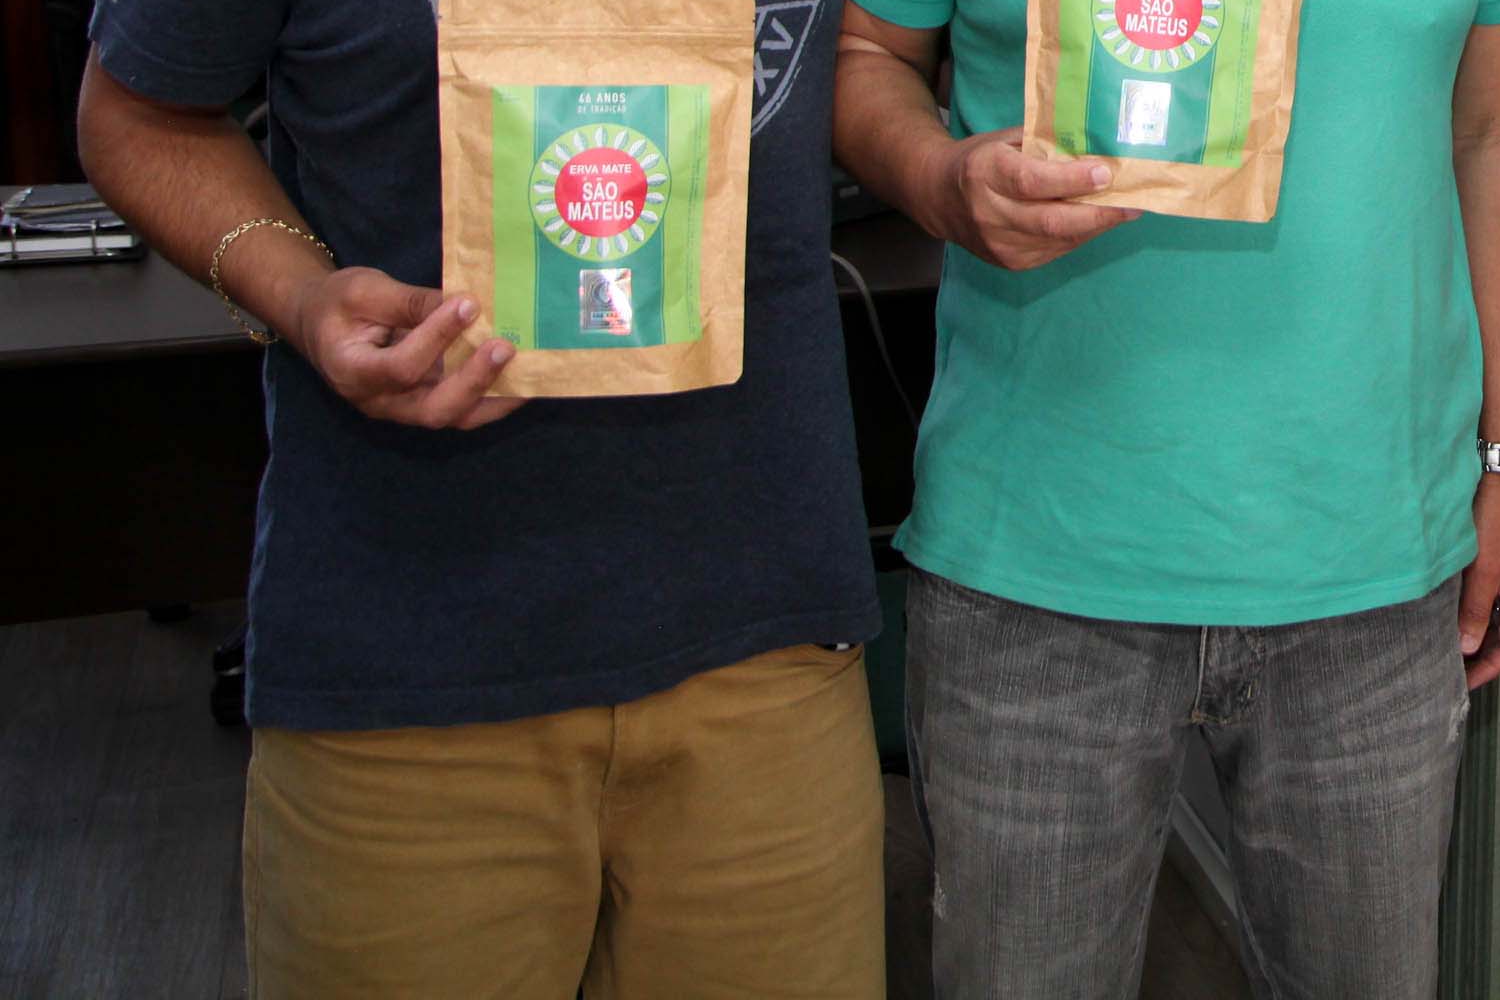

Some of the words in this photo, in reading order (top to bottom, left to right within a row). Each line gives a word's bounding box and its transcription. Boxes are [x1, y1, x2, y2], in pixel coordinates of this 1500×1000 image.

[1125, 12, 1188, 37] MATEUS
[596, 92, 626, 103] ANOS
[569, 164, 599, 175] ERVA
[602, 163, 632, 174] MATE
[582, 177, 618, 200] SÃO
[568, 200, 634, 222] MATEUS
